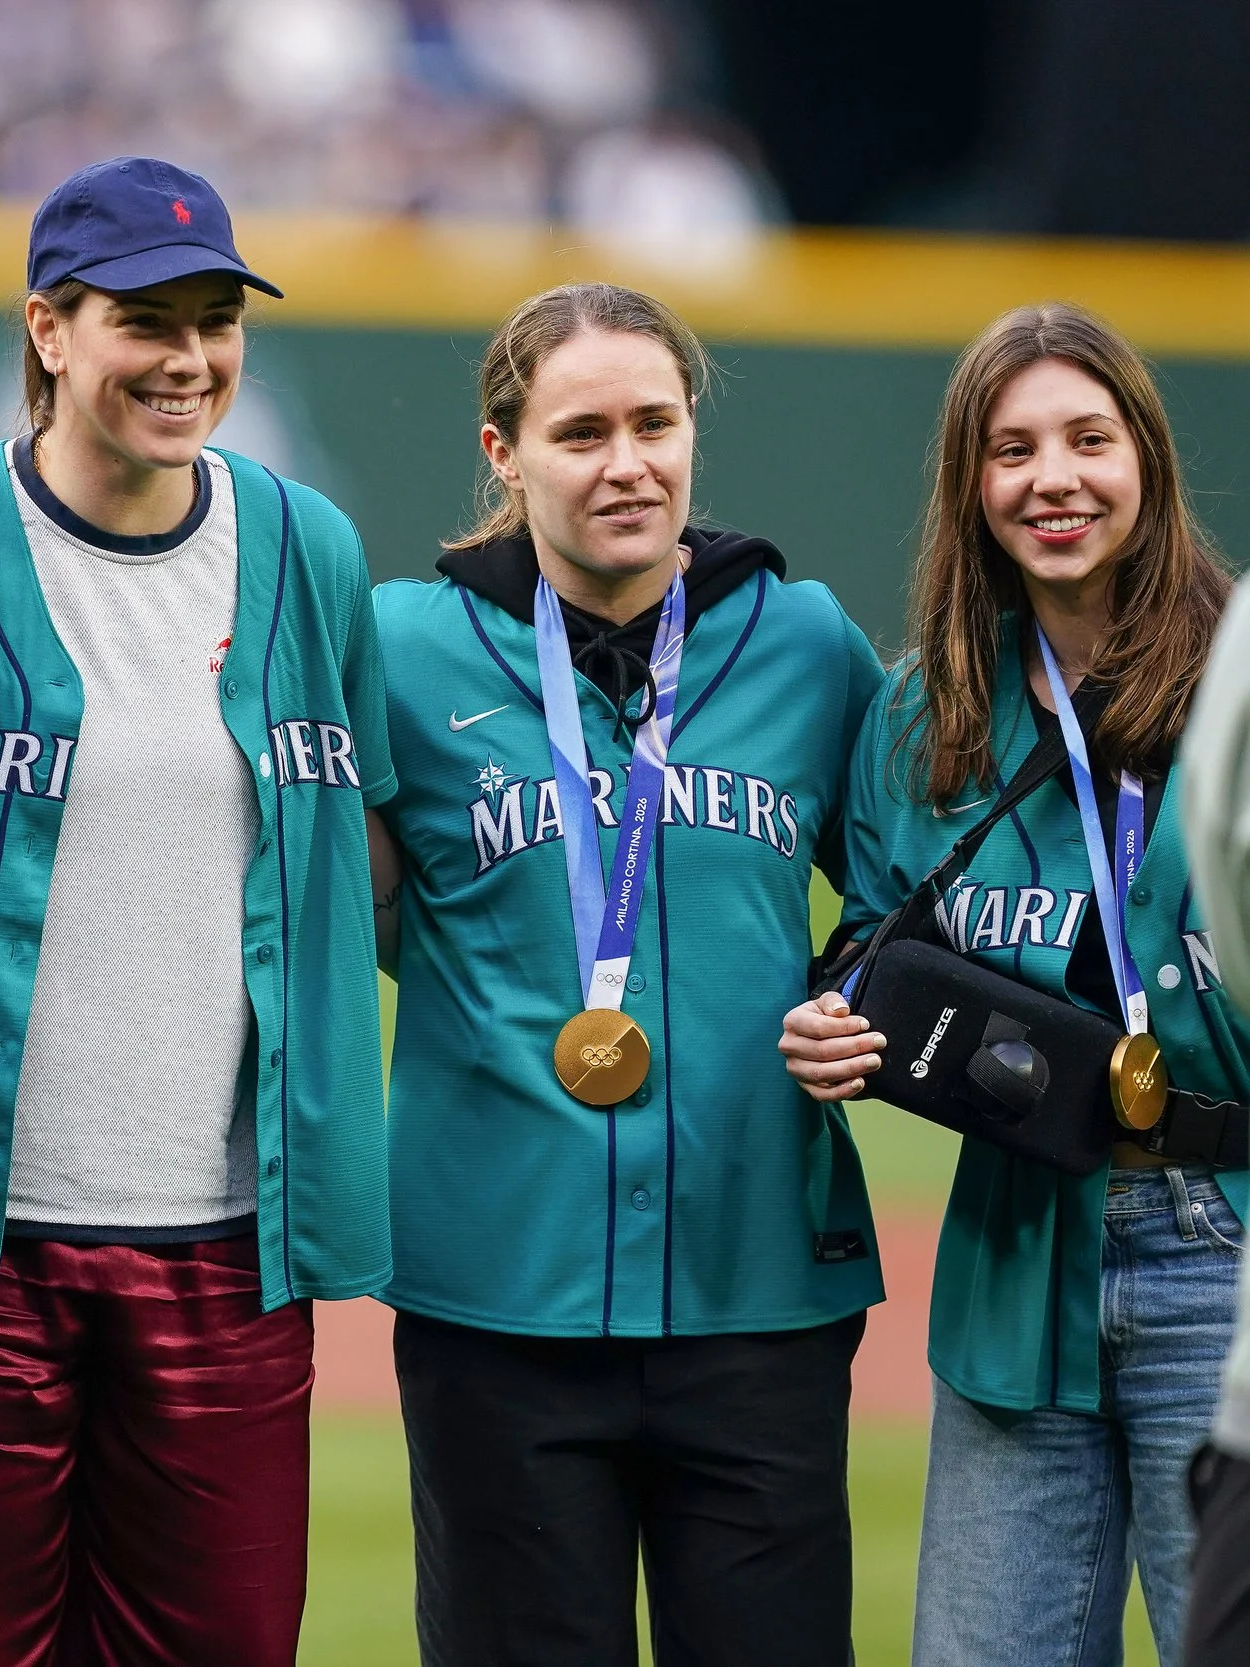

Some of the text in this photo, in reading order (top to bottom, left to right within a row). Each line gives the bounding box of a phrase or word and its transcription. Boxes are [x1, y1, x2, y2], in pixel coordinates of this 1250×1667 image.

[270, 719, 360, 789] NER
[472, 764, 799, 877] MARNERS
[615, 797, 648, 931] MILANO CORTINA 2026
[1126, 829, 1135, 855] 2026
